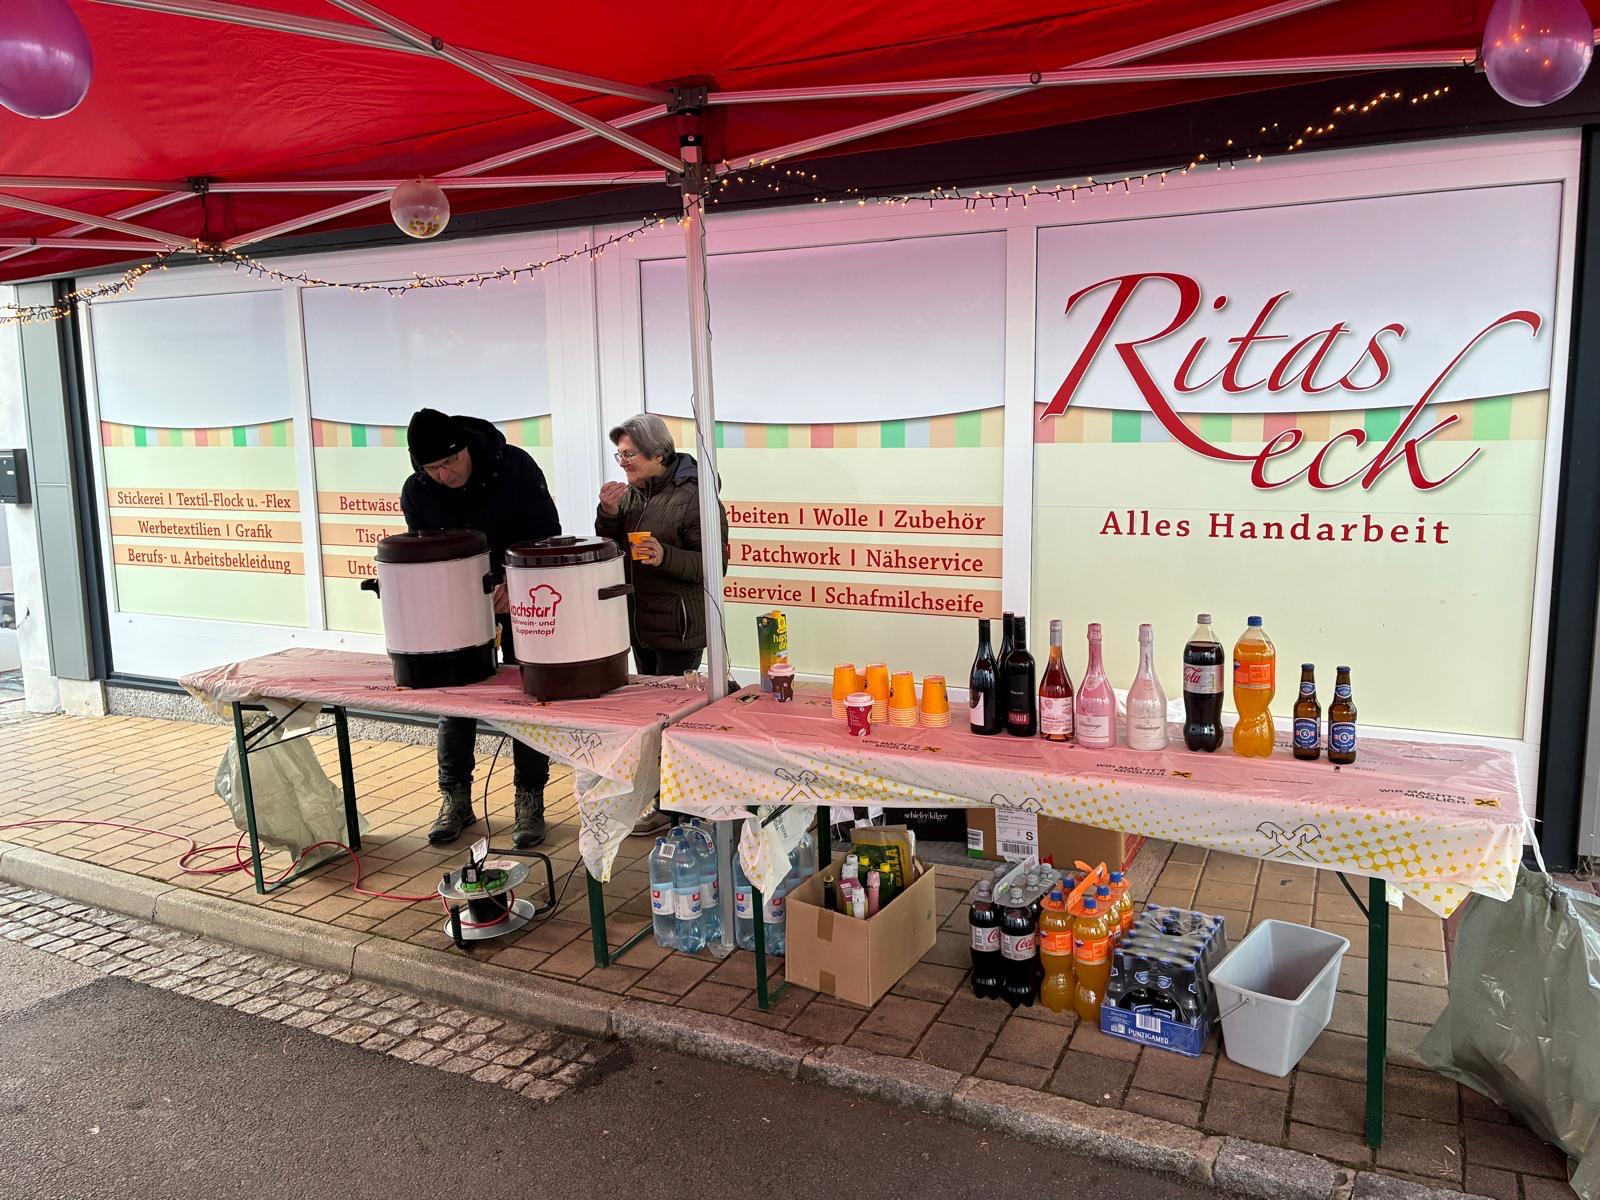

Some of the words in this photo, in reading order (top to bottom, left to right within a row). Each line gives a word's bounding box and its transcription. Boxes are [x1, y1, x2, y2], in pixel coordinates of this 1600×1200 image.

[1039, 271, 1406, 461] Ritas
[1250, 309, 1541, 491] eck
[117, 491, 164, 505] Stickerei
[176, 492, 244, 508] Textil-Flock
[247, 497, 258, 508] u.
[261, 493, 291, 509] -Flex
[339, 496, 403, 512] Bettwäsc
[138, 520, 221, 536] Werbetextilien
[235, 523, 273, 538] Grafik
[813, 507, 868, 526] Wolle
[894, 509, 985, 530] Zubehör
[1100, 509, 1191, 537] Alles
[1208, 513, 1450, 544] Handarbeit
[128, 548, 168, 564] Berufs-
[171, 556, 181, 565] u.
[184, 551, 291, 574] Arbeitsbekleidung
[347, 560, 378, 576] Unte
[741, 543, 841, 566] Patchwork
[866, 549, 983, 572] Nähservice
[723, 582, 802, 602] eiservice
[825, 587, 984, 613] Schafmilchseife
[539, 618, 556, 627] und
[1025, 831, 1034, 841] S
